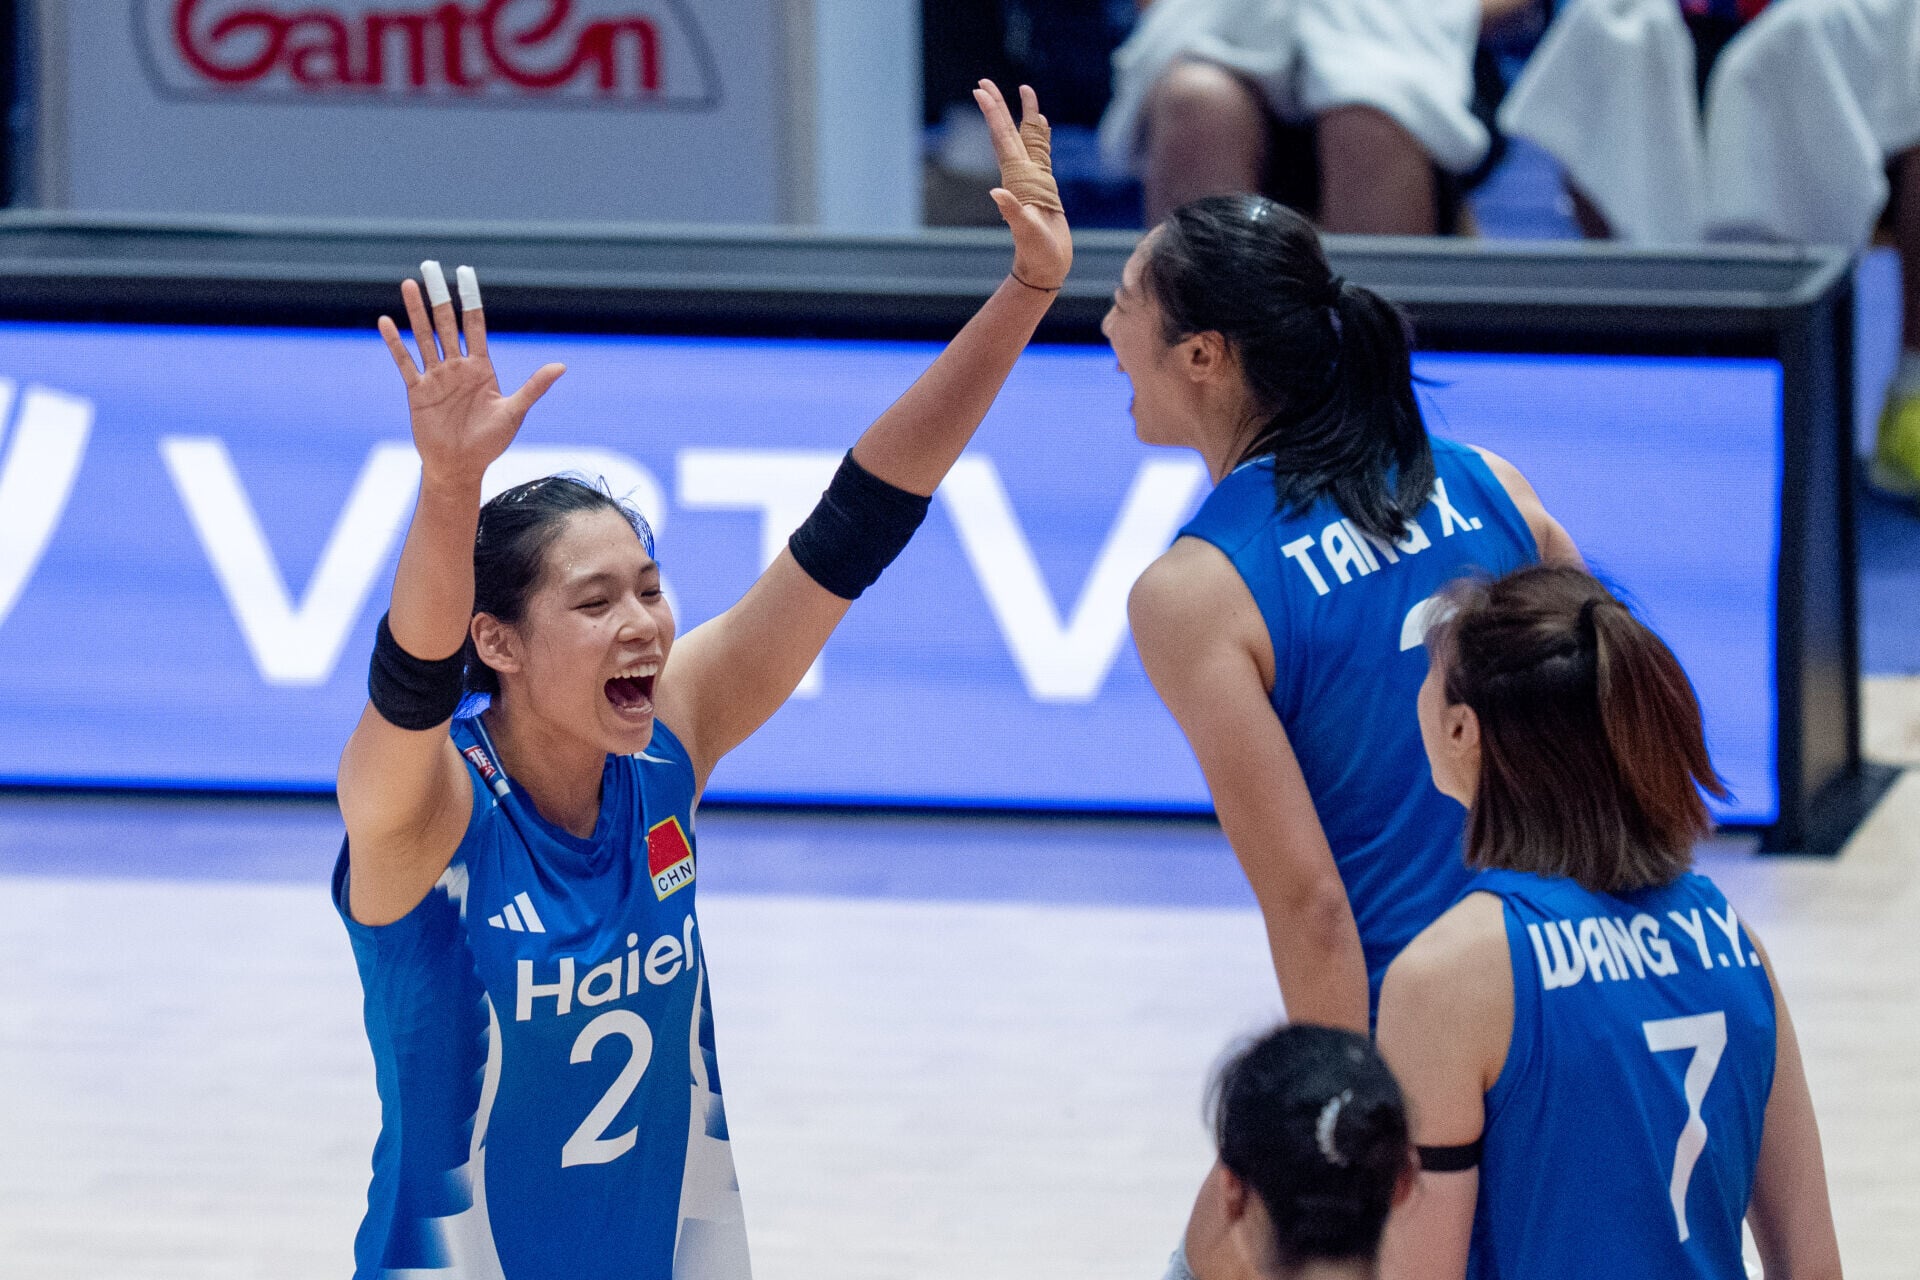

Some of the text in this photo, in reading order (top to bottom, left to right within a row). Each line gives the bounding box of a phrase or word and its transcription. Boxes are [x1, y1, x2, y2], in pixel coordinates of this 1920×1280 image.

[160, 434, 1203, 703] VTV
[658, 861, 692, 892] CHN
[516, 914, 695, 1022] Haier
[1527, 904, 1761, 991] WANG Y.Y.
[561, 1009, 654, 1169] 2
[1642, 1010, 1728, 1244] 7
